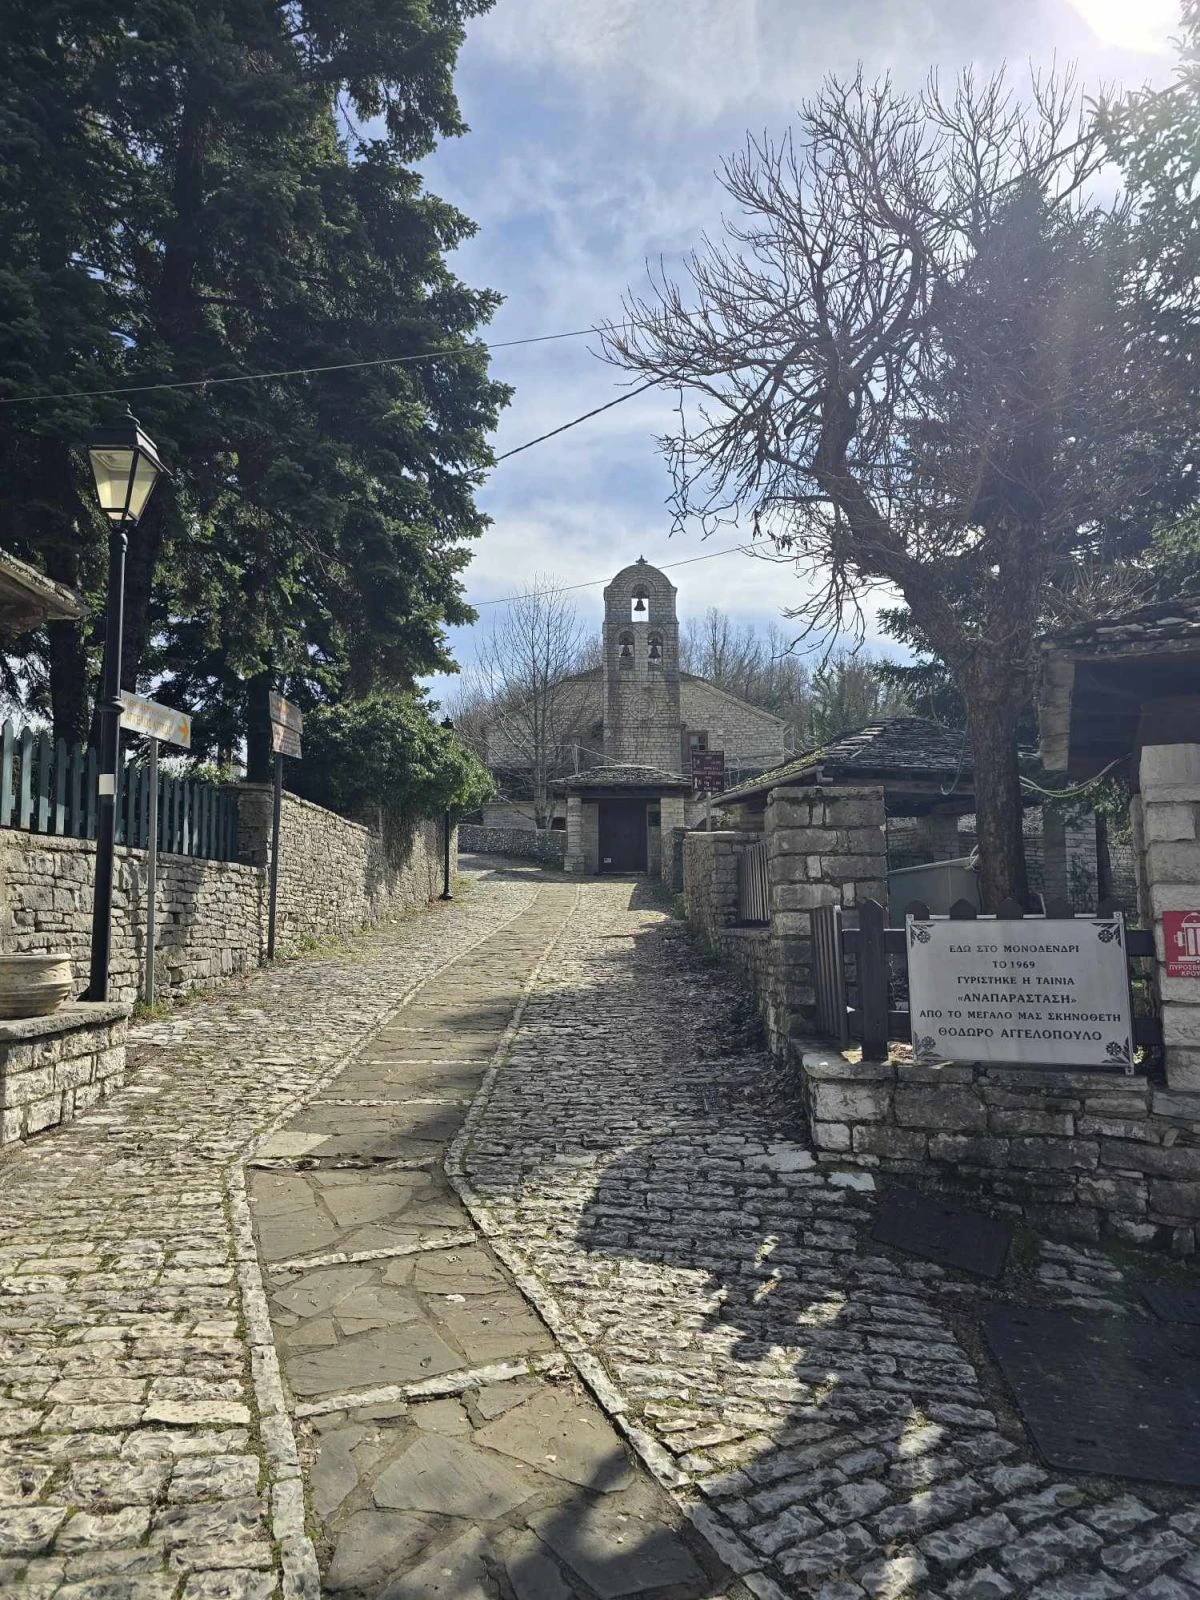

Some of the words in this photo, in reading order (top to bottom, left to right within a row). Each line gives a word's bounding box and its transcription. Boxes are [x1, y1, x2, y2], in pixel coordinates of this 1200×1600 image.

[949, 945, 972, 953] ΕΔΩ
[976, 945, 998, 953] ΣΤΟ
[1003, 945, 1080, 953] ΜΟΝΟΔΕΝΔΡΙ
[992, 960, 1007, 969] ΤΟ
[1011, 960, 1036, 969] 1969
[957, 976, 1017, 985] ΓΥΡΙΣΤΗΚΕ
[1022, 977, 1031, 985] Η
[1036, 977, 1075, 985] ΤΑΙΝΙΑ
[919, 1009, 942, 1018] ΑΠΟ
[948, 1010, 962, 1019] ΤΟ
[967, 1010, 1013, 1019] ΜΕΓΑΛΟ
[1018, 1012, 1042, 1020] ΜΑΣ
[1048, 1012, 1121, 1022] ΣΚΗΝΟΘΕΤΗ
[938, 1027, 994, 1038] ΘΟΔΩΡΟ
[1000, 1028, 1103, 1041] ΑΓΓΕΛΟΠΟΥΛΟ
